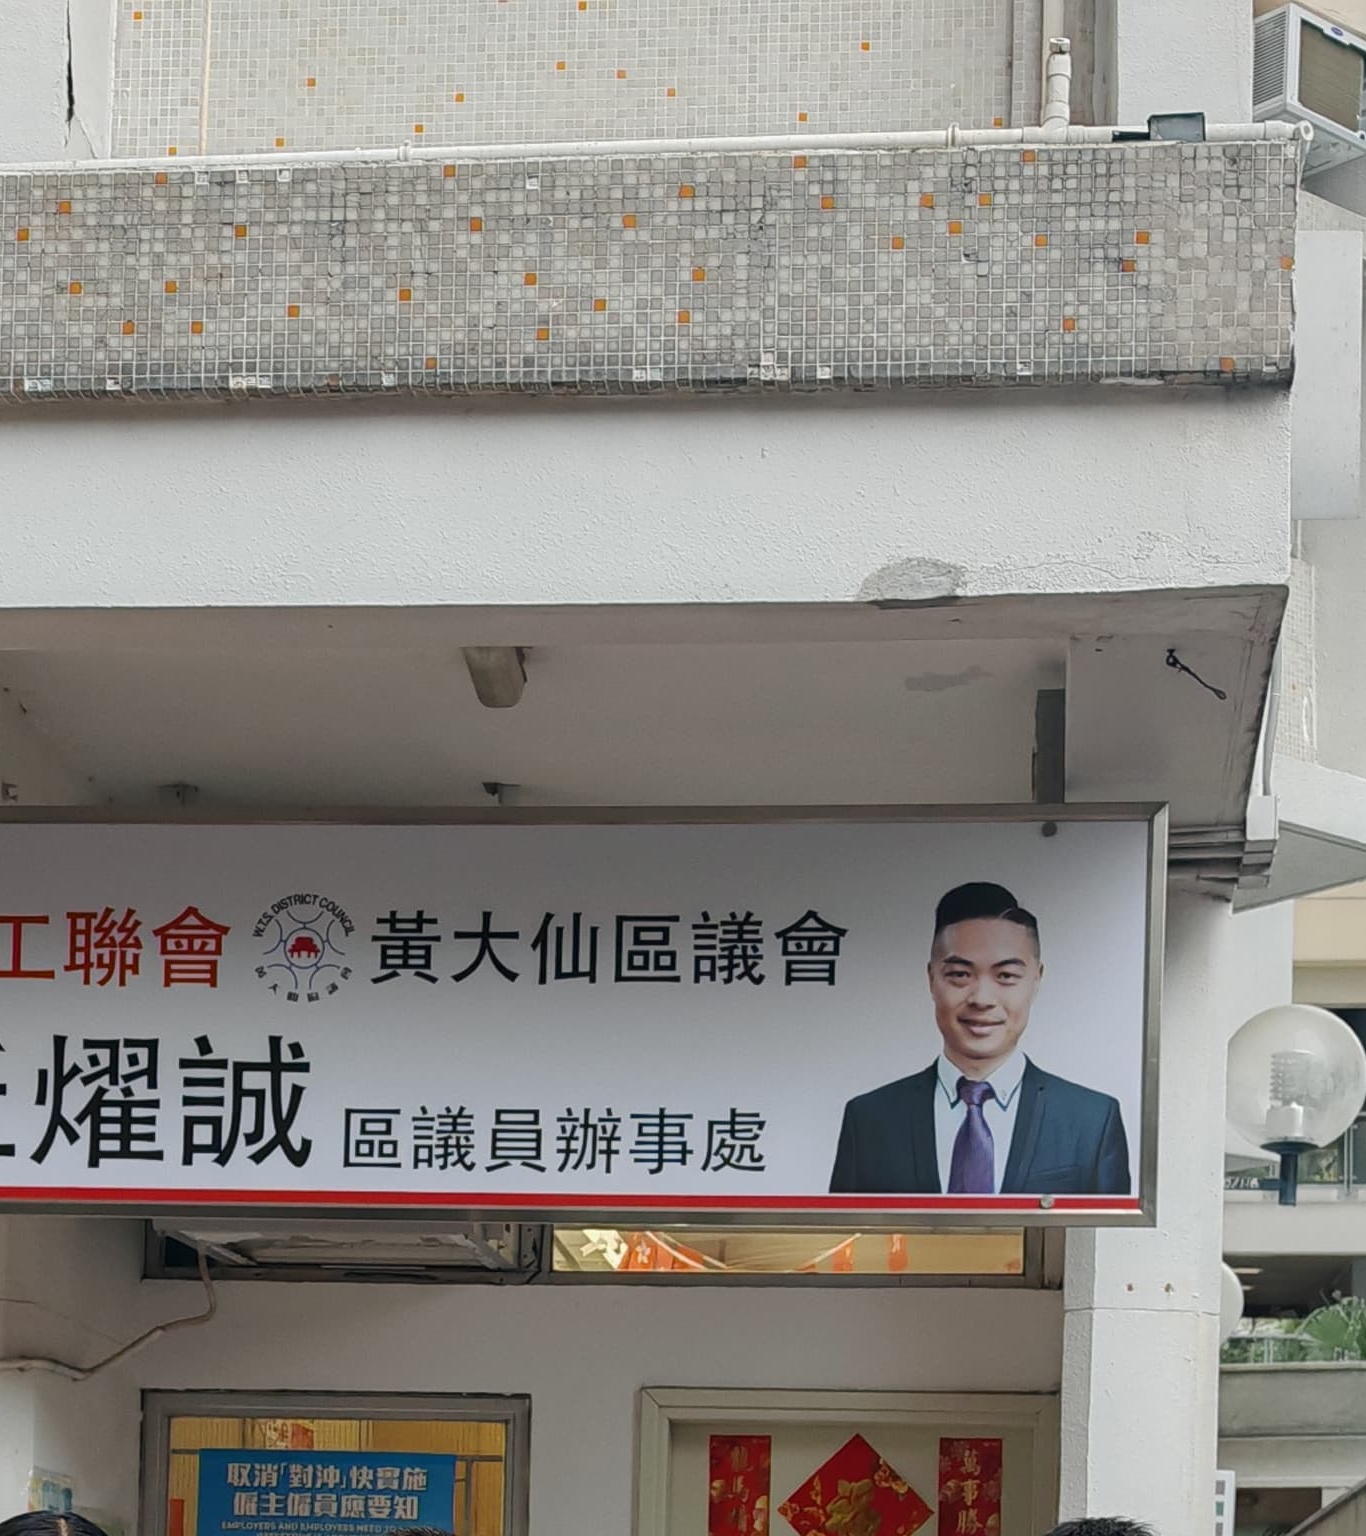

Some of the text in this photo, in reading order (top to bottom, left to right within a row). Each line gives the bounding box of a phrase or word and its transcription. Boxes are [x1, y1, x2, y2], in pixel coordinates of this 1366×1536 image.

[271, 893, 320, 914] DISTRICT
[319, 897, 355, 938] COUNCIL
[369, 907, 850, 987] 黃大仙區議會
[341, 1106, 767, 1175] 區議員辦事處
